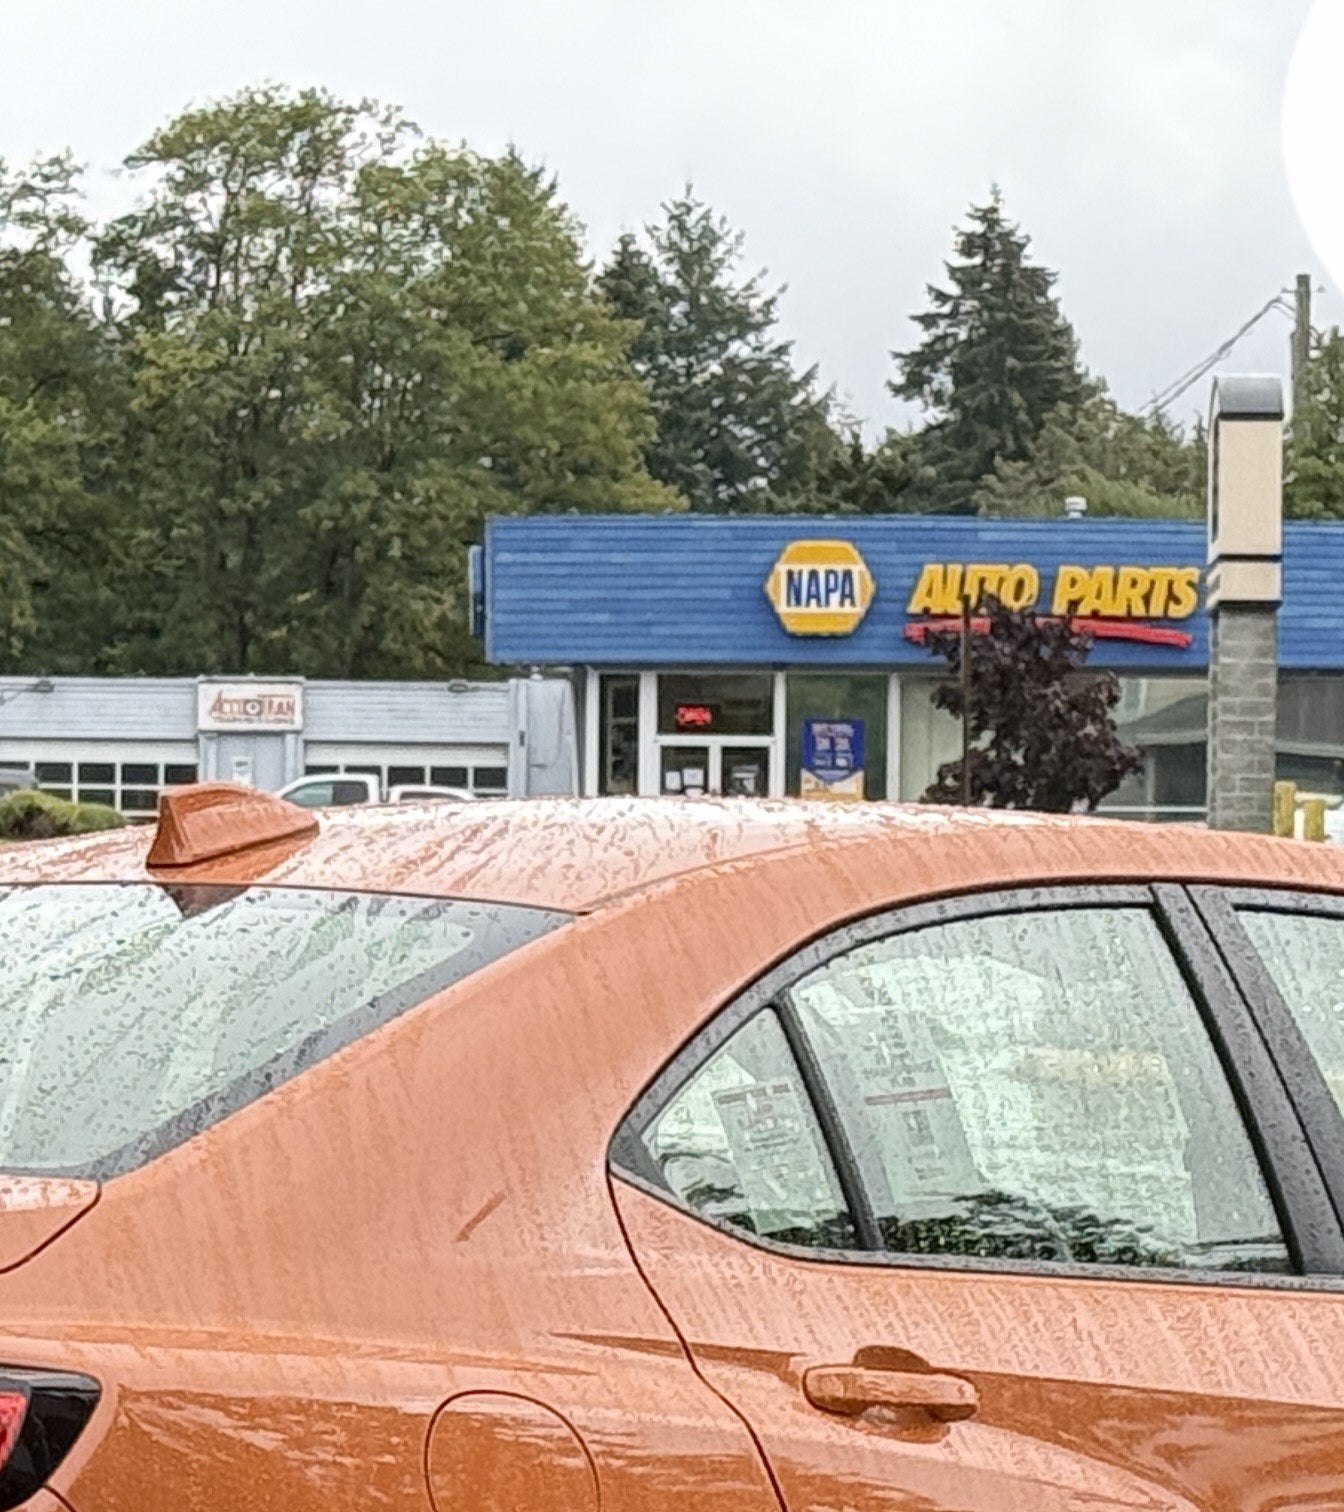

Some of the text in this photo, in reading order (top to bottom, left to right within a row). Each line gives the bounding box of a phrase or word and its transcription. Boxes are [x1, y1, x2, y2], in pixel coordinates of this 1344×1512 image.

[786, 568, 857, 609] NAPA
[906, 563, 1202, 618] AUTO PARTS
